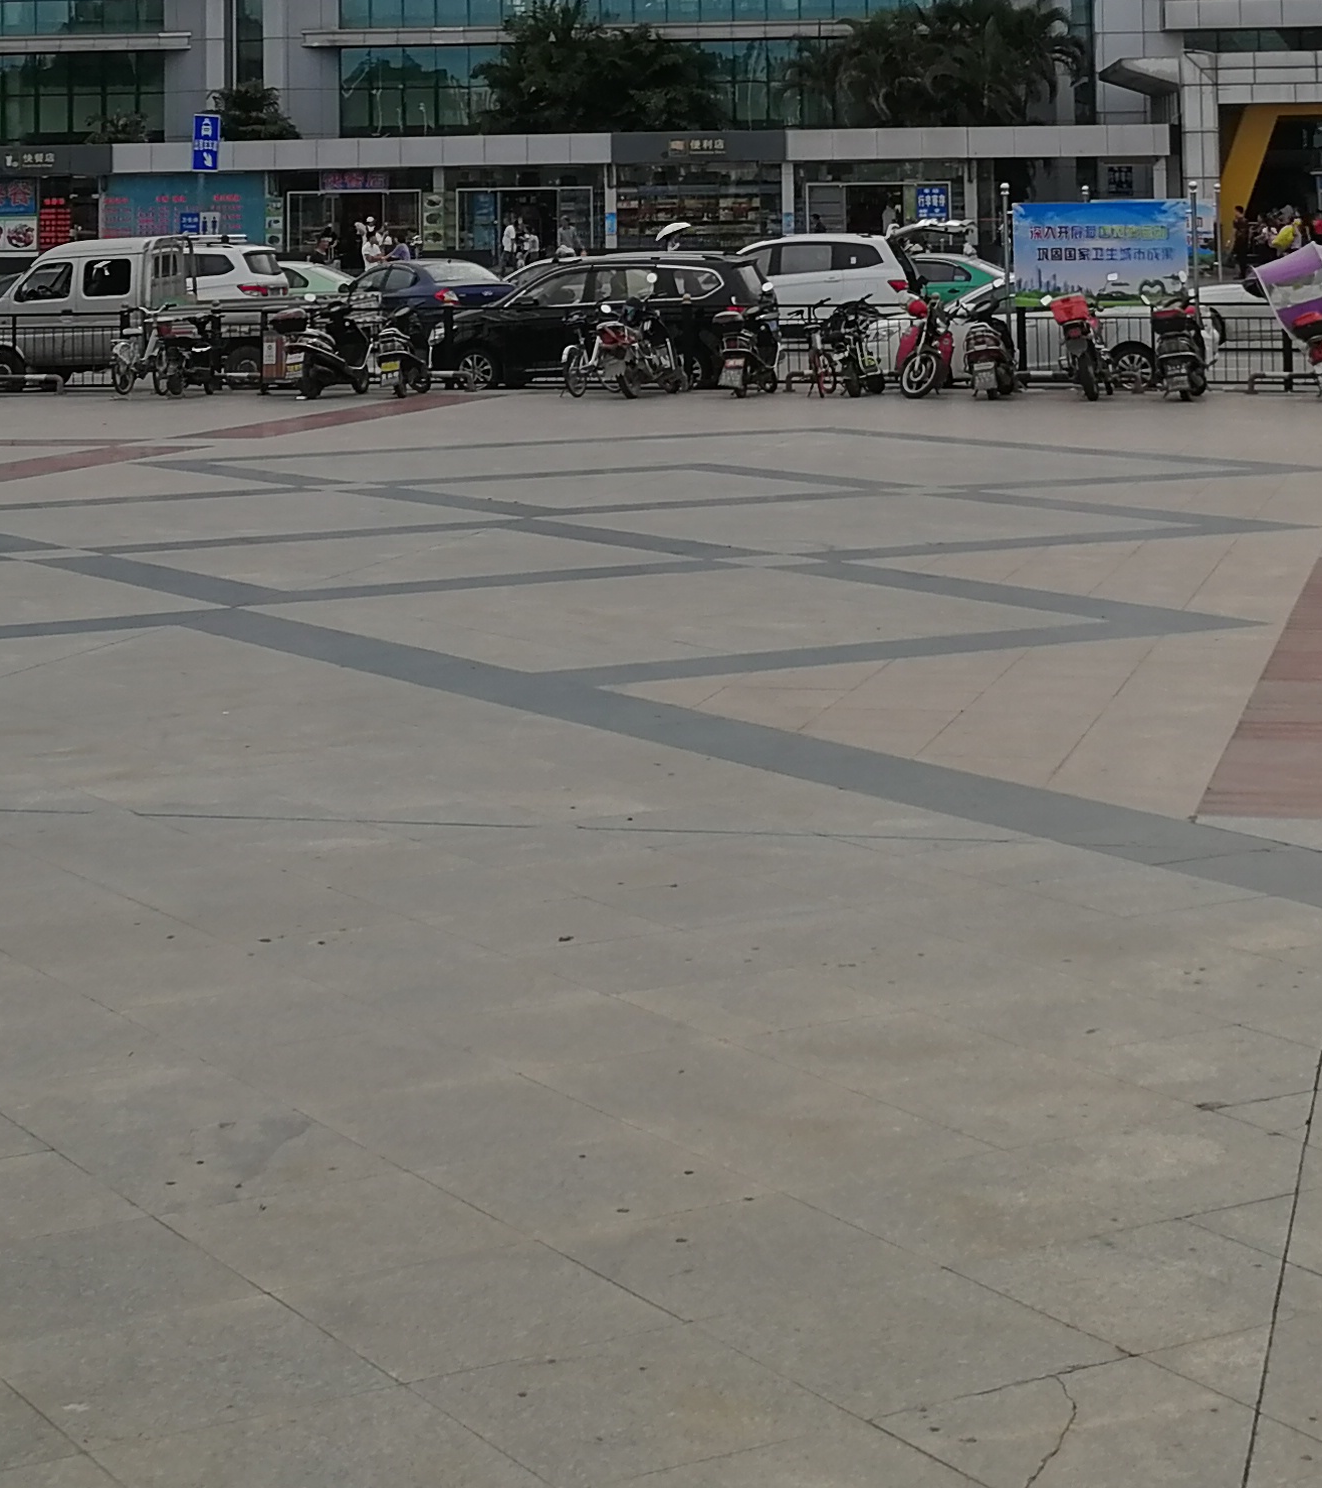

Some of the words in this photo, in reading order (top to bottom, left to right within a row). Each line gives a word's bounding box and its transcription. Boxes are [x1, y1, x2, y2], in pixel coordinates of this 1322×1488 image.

[690, 139, 724, 150] 便利店
[22, 153, 55, 163] 快餐店
[1037, 247, 1175, 262] 巩固国家卫生城市成果
